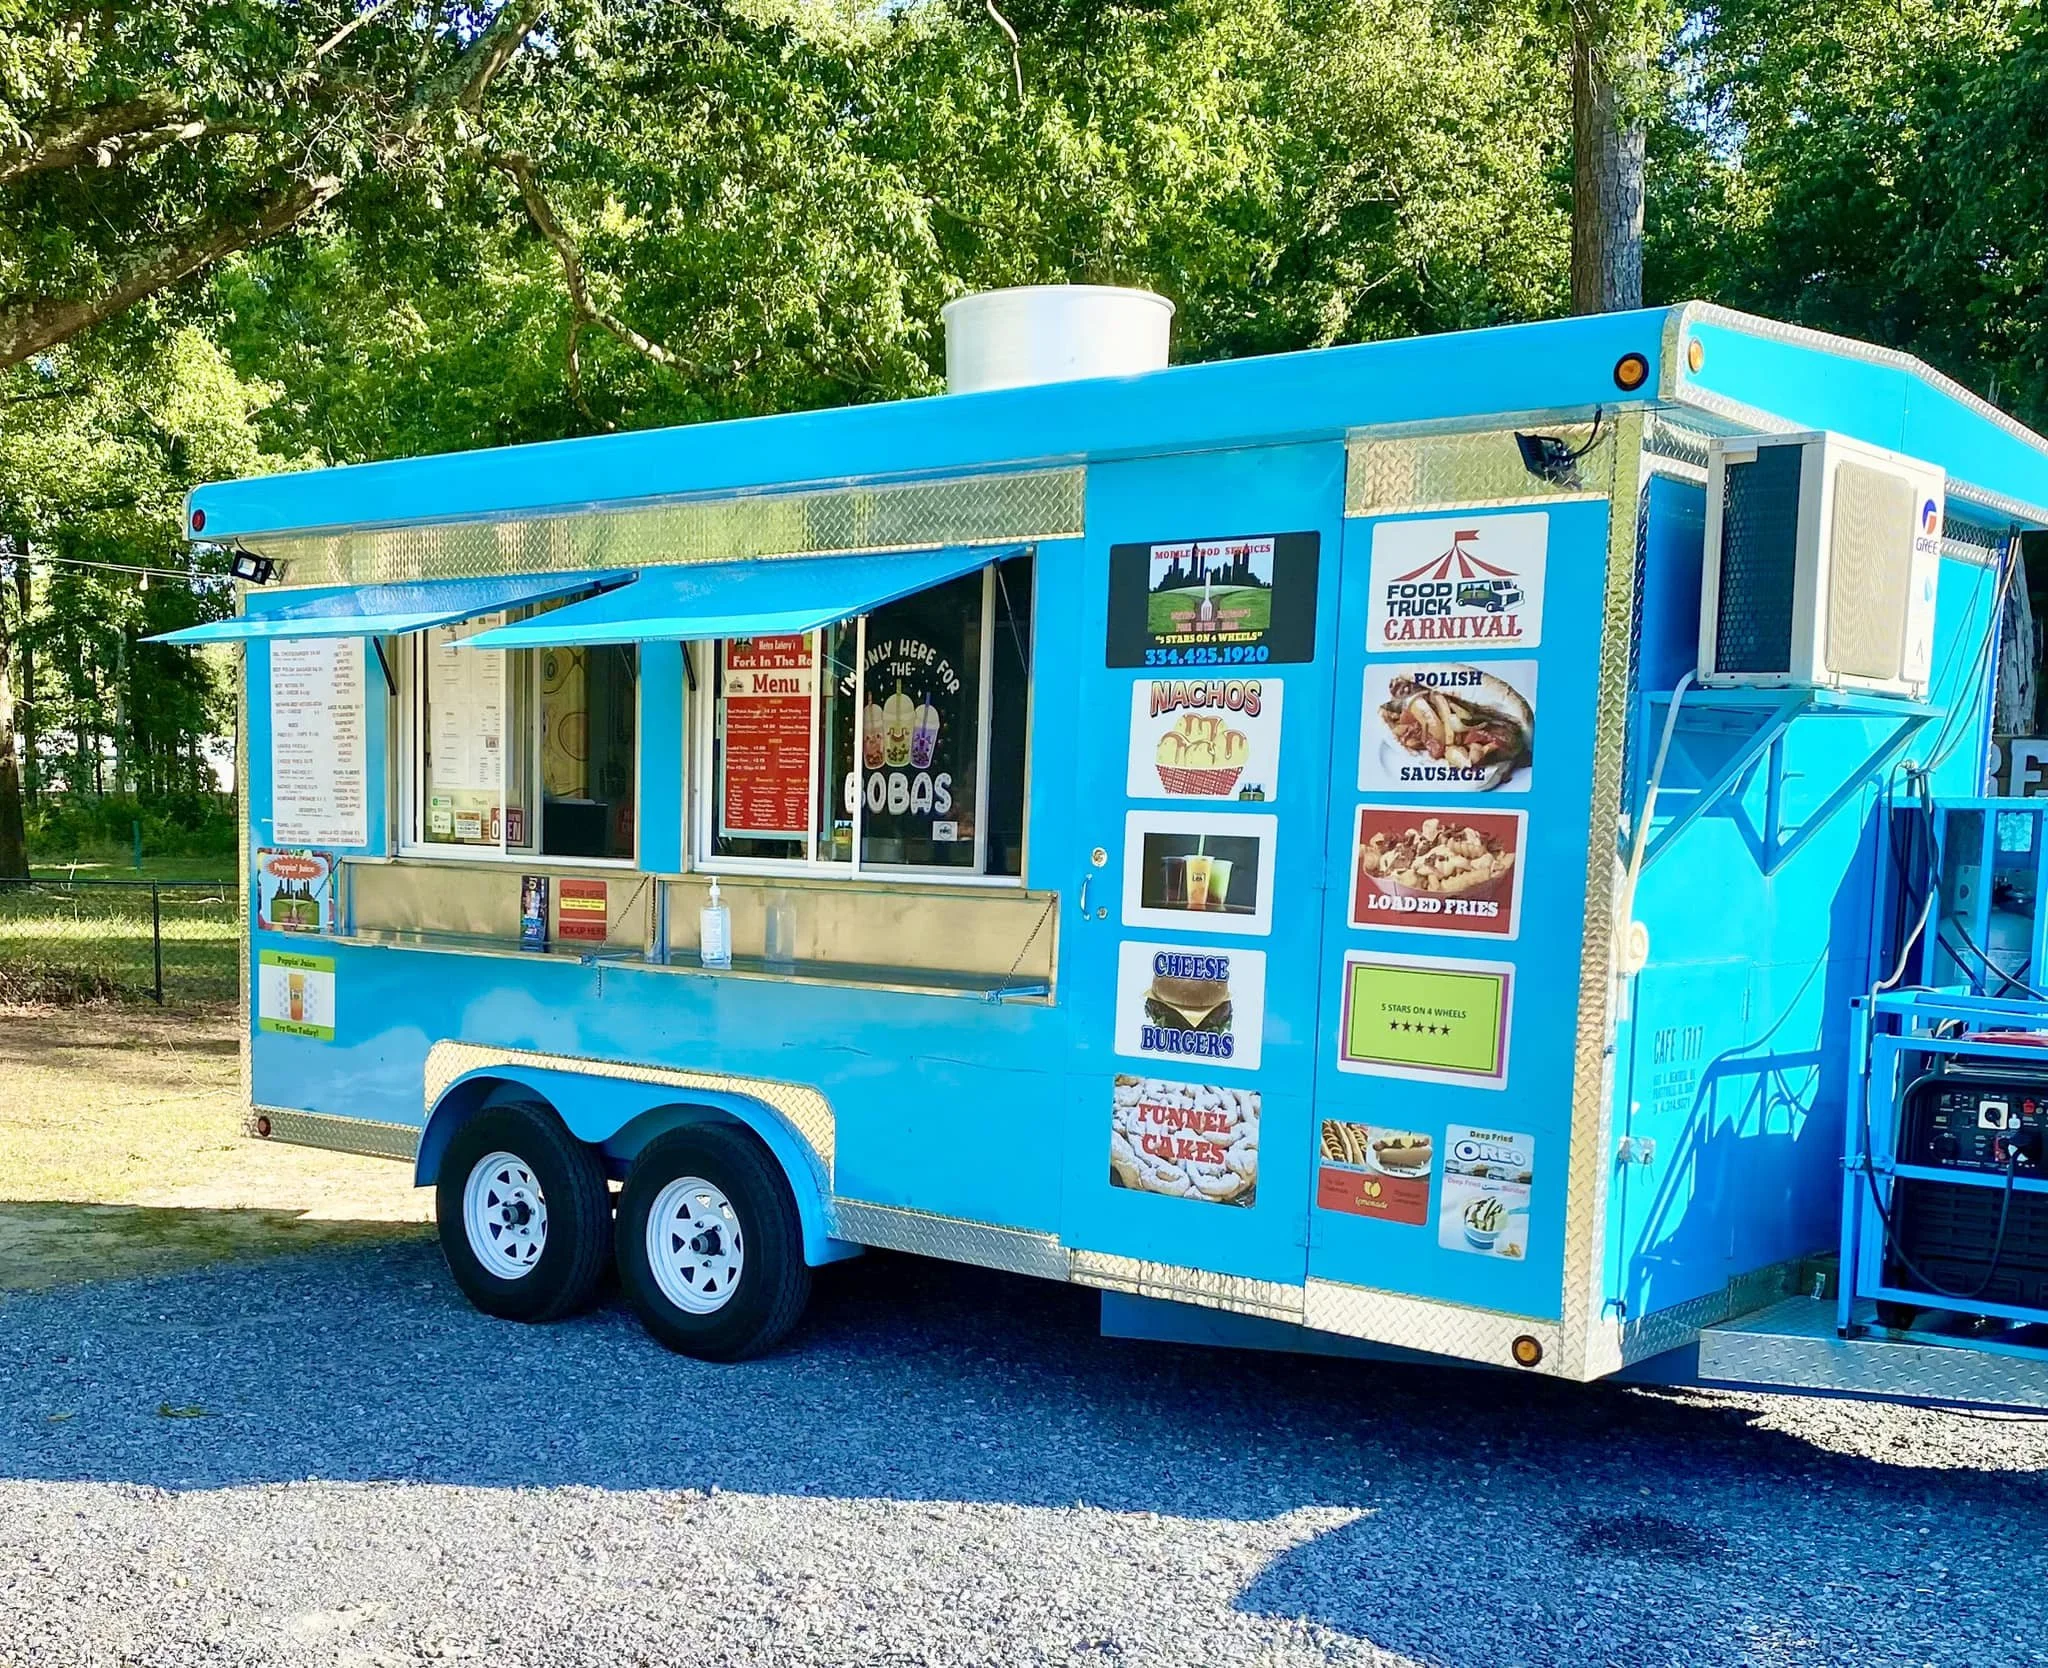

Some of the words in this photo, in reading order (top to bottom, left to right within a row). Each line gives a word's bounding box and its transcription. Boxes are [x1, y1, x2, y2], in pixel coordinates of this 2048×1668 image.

[1916, 537, 1938, 555] GREE
[1387, 582, 1453, 599] FOOD
[1387, 598, 1453, 617] TRUCK
[1384, 614, 1523, 641] CARNIVAL
[1166, 634, 1195, 643] STARS
[1196, 633, 1210, 642] ON
[1211, 634, 1217, 642] 4
[733, 656, 756, 667] Fork
[760, 656, 771, 667] In
[774, 655, 795, 666] The
[798, 654, 812, 666] Ro
[1145, 646, 1269, 665] 334.425.1920
[900, 639, 936, 666] HERE
[937, 660, 960, 695] FOR
[752, 674, 800, 693] Menu
[1414, 671, 1484, 687] POLISH
[1150, 680, 1261, 718] NACHOS
[1400, 767, 1485, 781] SAUSAGE
[844, 772, 952, 815] BOBAS
[491, 820, 521, 840] OEN
[274, 863, 298, 875] Poppin'
[299, 864, 315, 873] Juice
[1368, 894, 1442, 914] LOADED
[1444, 898, 1499, 918] FRIES
[277, 956, 299, 967] Poppin'
[300, 958, 316, 968] Juice
[1153, 951, 1230, 983] CHEESE
[1381, 1003, 1387, 1011] 5
[1388, 1004, 1412, 1014] STARS
[1413, 1006, 1426, 1015] ON
[1427, 1007, 1433, 1015] 4
[1434, 1008, 1467, 1019] WHEELS
[1141, 1024, 1234, 1059] BURGERS
[1654, 1028, 1676, 1064] CAFE
[1682, 1026, 1703, 1061] 1717
[1138, 1104, 1231, 1134] FUNNEL
[1470, 1130, 1490, 1140] Deep
[1492, 1134, 1513, 1143] Fried
[1142, 1133, 1225, 1165] CAKES
[1454, 1140, 1526, 1167] OREO
